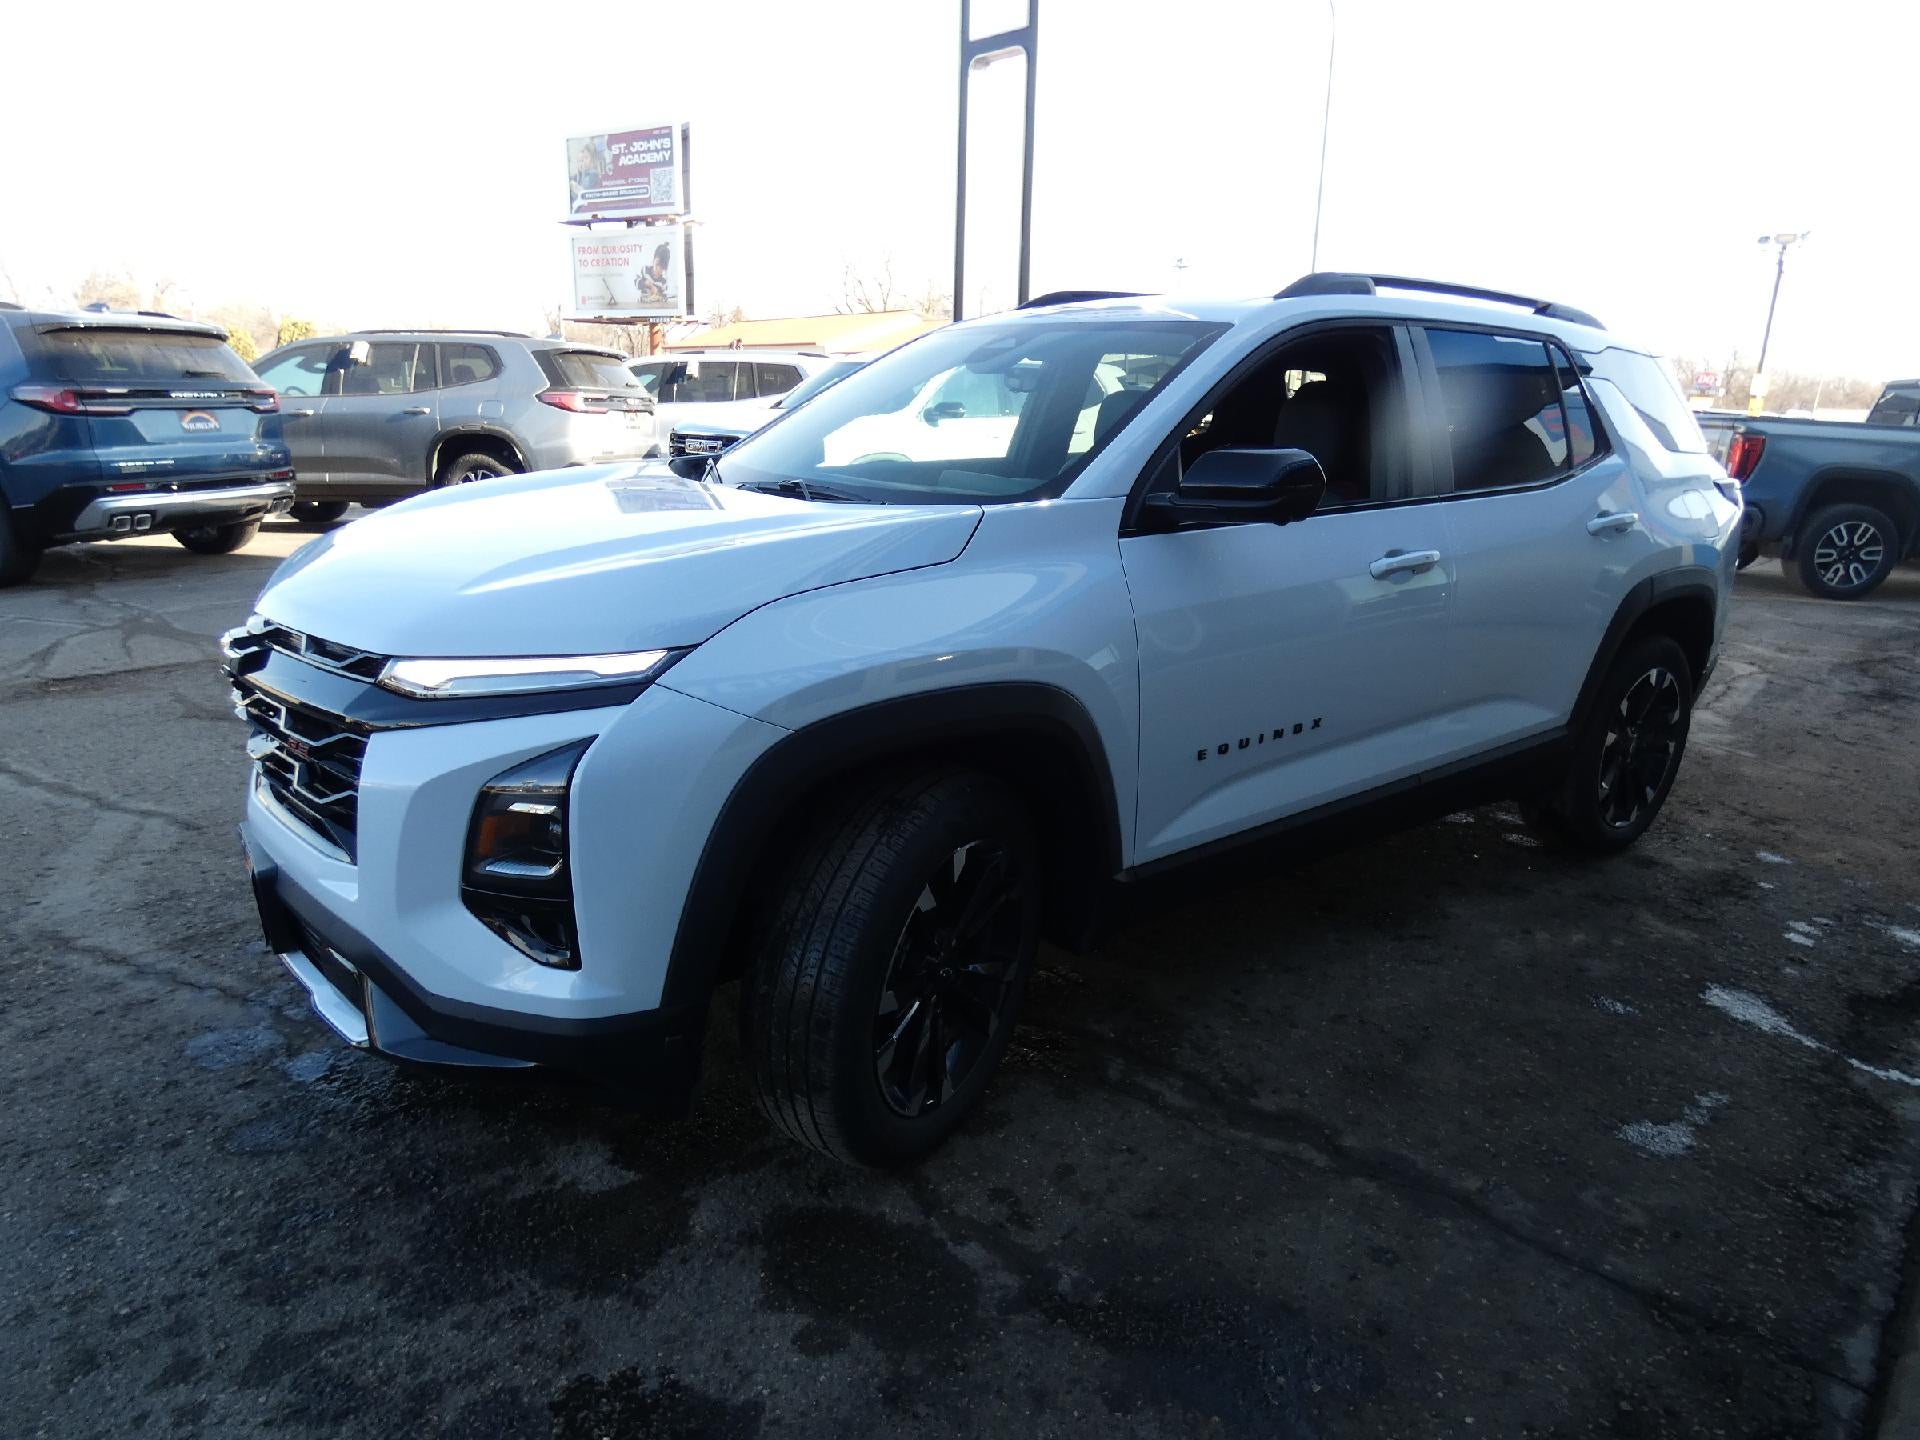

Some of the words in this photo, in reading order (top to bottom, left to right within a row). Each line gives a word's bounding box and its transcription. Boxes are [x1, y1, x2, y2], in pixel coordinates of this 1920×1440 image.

[611, 143, 628, 154] ST.
[630, 138, 671, 152] JOHN'S
[619, 151, 671, 166] ACADEMY
[577, 245, 598, 255] FROM
[602, 244, 643, 254] CURIOSITY
[578, 259, 589, 267] TO
[590, 257, 630, 267] CREATION
[1197, 717, 1323, 761] EQUINOX
